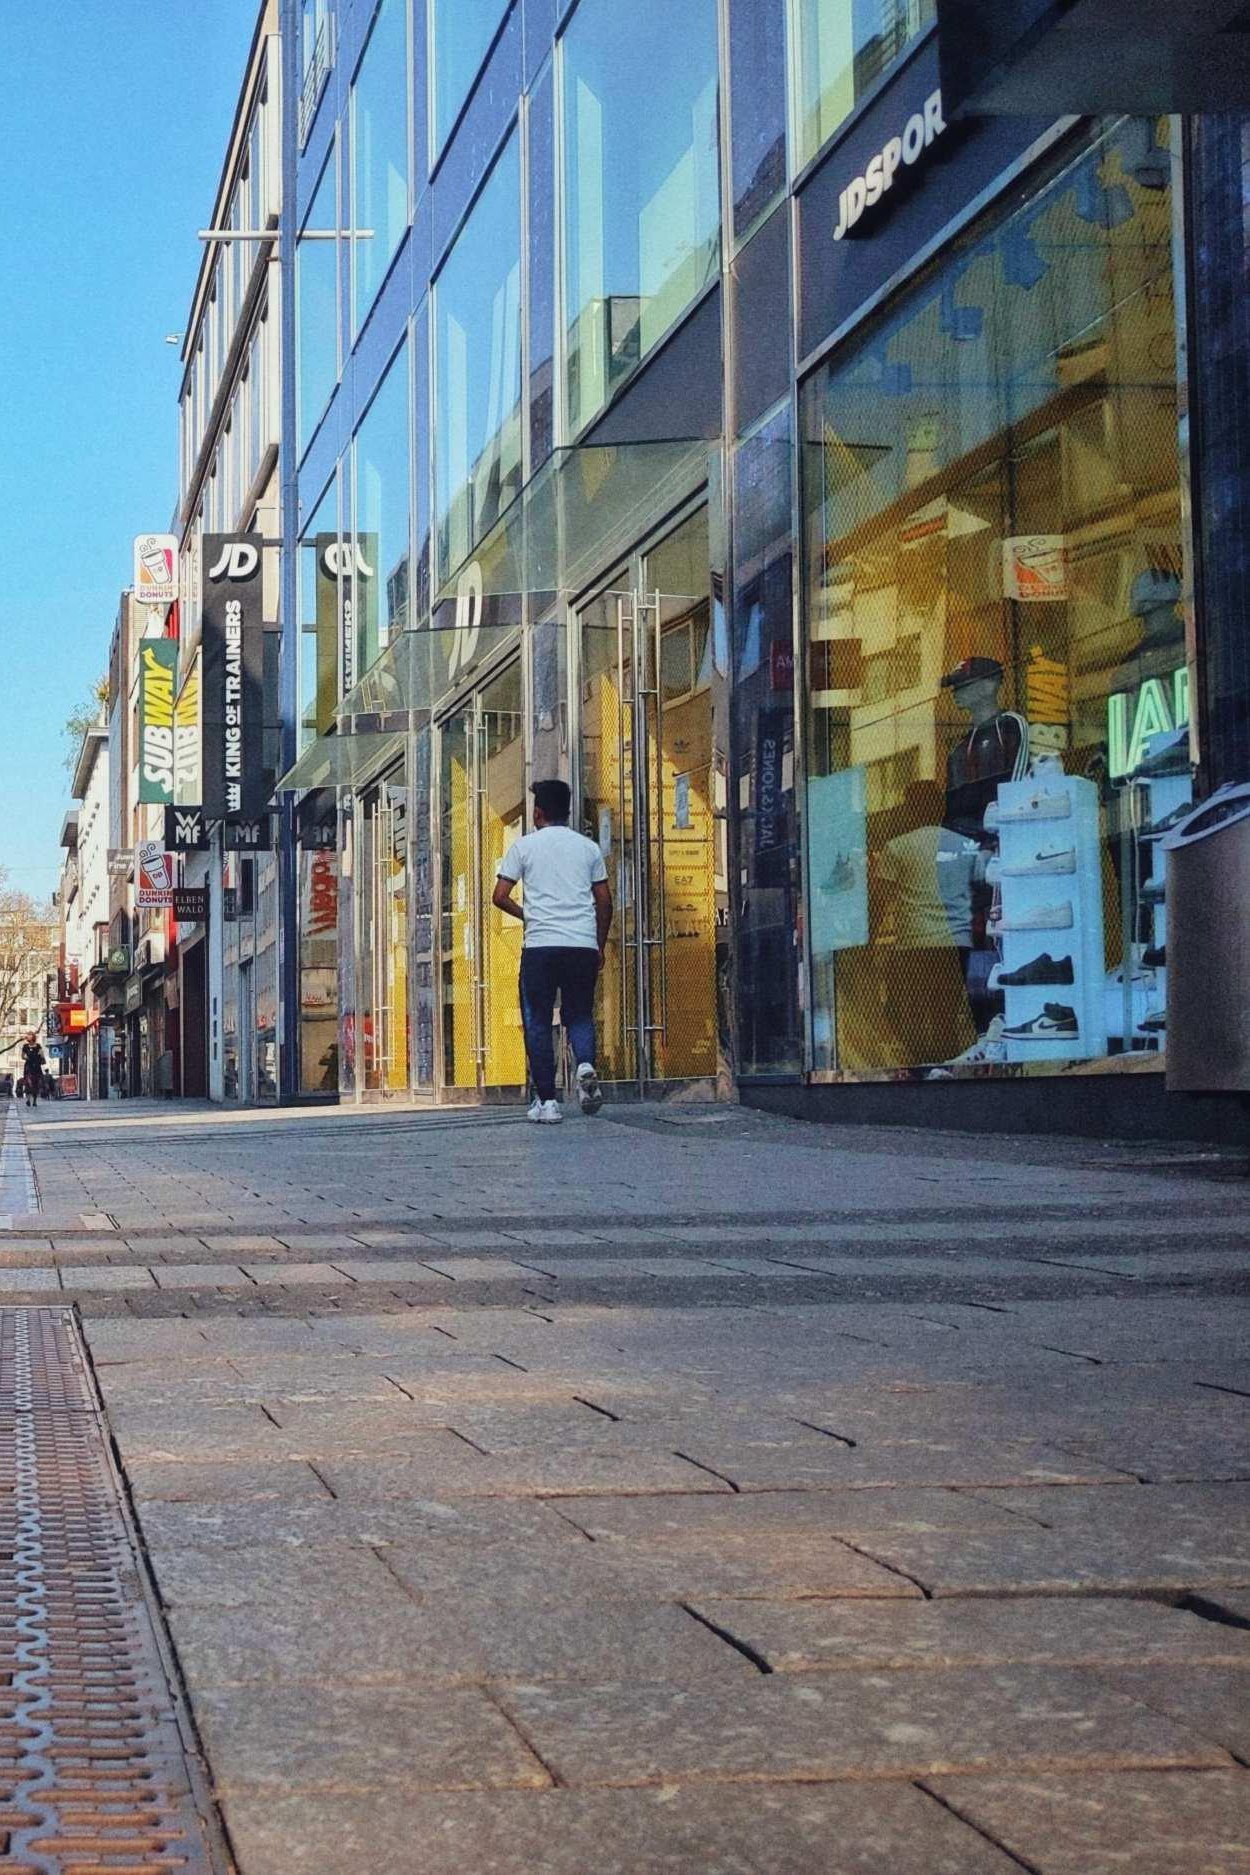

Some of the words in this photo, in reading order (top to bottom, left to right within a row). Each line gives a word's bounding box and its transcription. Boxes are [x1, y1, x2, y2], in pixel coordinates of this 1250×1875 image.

[209, 543, 258, 578] JD
[448, 560, 483, 681] JD
[225, 600, 241, 702] TRAINERS
[142, 648, 174, 794] SUBWAY
[226, 705, 241, 726] OF
[226, 727, 241, 778] KING
[176, 895, 204, 904] ELBEN
